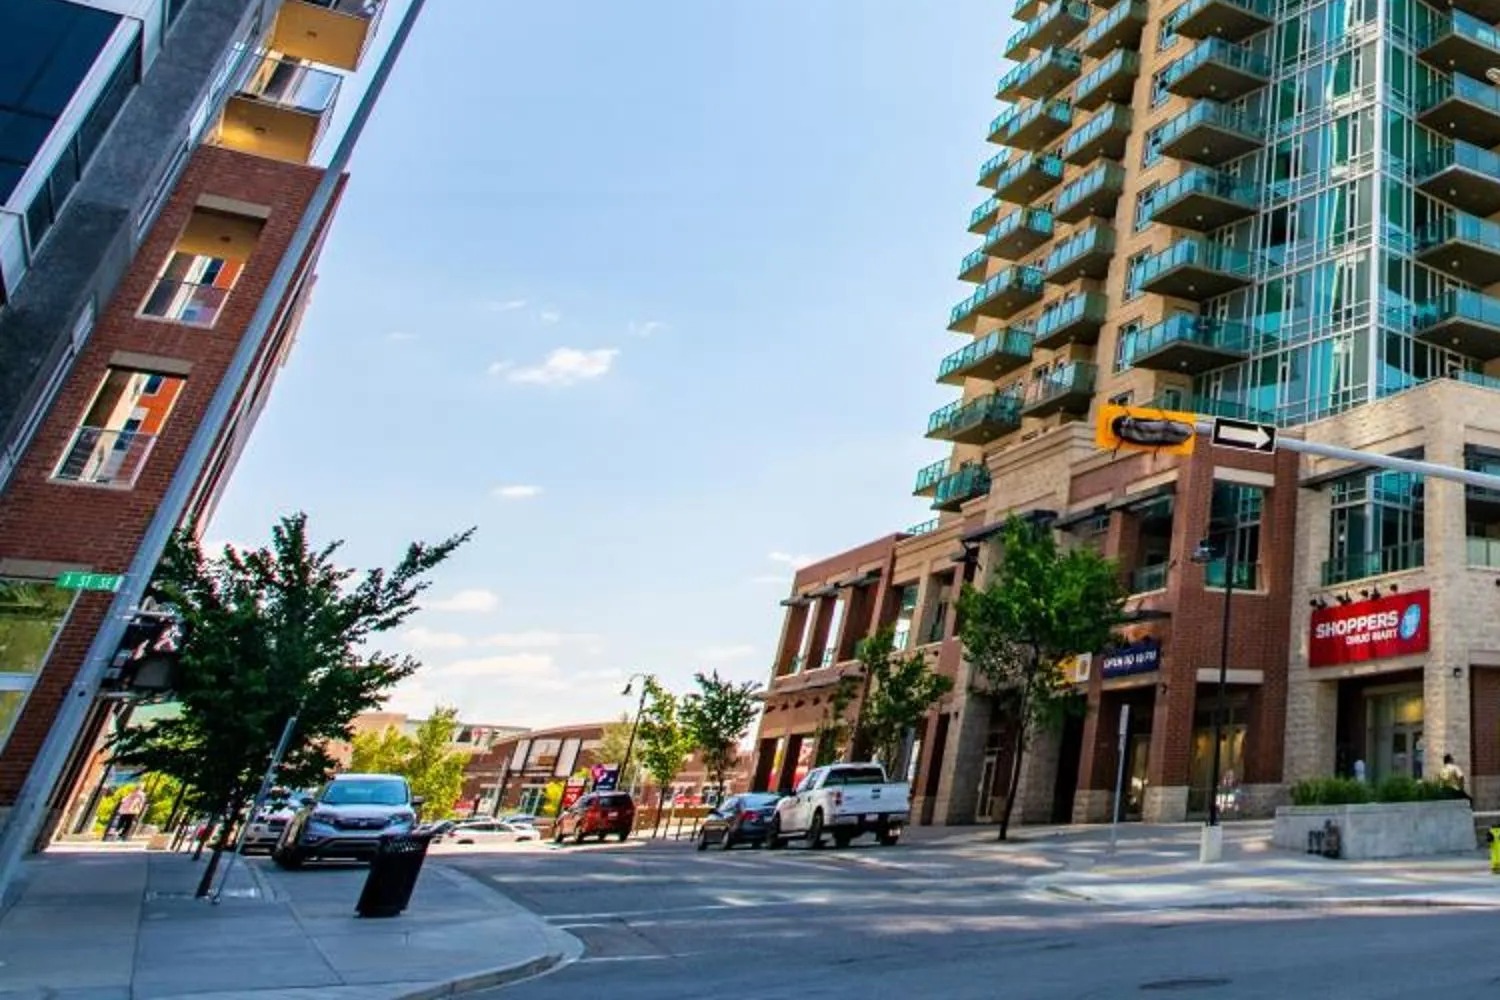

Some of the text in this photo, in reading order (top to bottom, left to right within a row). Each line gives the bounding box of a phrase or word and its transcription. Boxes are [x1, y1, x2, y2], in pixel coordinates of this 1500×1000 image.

[1316, 610, 1399, 639] SHOPPERS
[1345, 628, 1398, 645] DRUG MART
